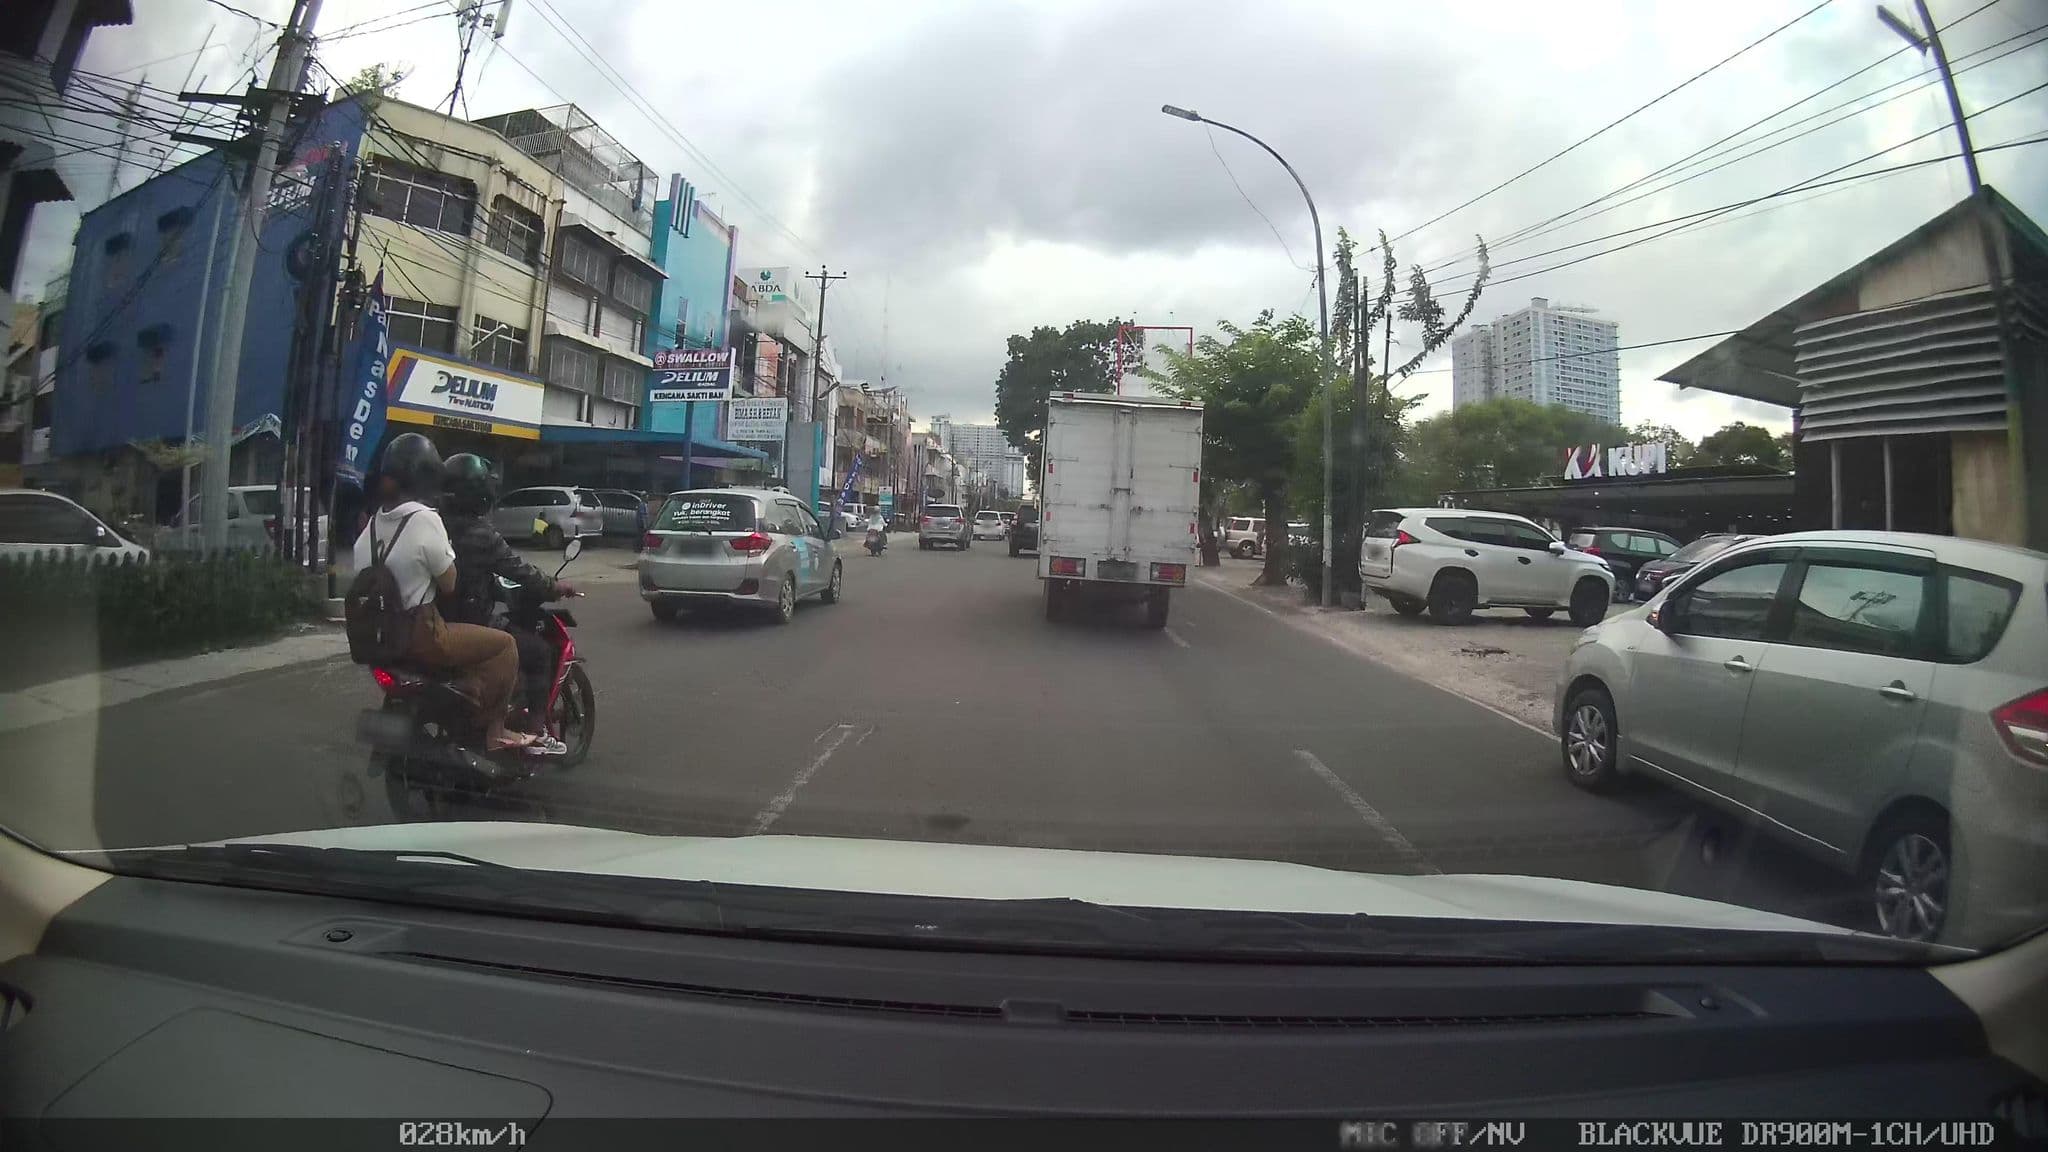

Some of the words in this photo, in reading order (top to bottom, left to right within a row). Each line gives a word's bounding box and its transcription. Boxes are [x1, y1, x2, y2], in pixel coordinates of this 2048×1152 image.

[667, 352, 729, 364] SWALLOW
[661, 371, 719, 384] DELIUM
[431, 370, 498, 402] DELIUM
[654, 391, 685, 400] KENCANA
[687, 391, 707, 400] SAKTI
[709, 391, 724, 399] BAN
[465, 399, 494, 412] NATION
